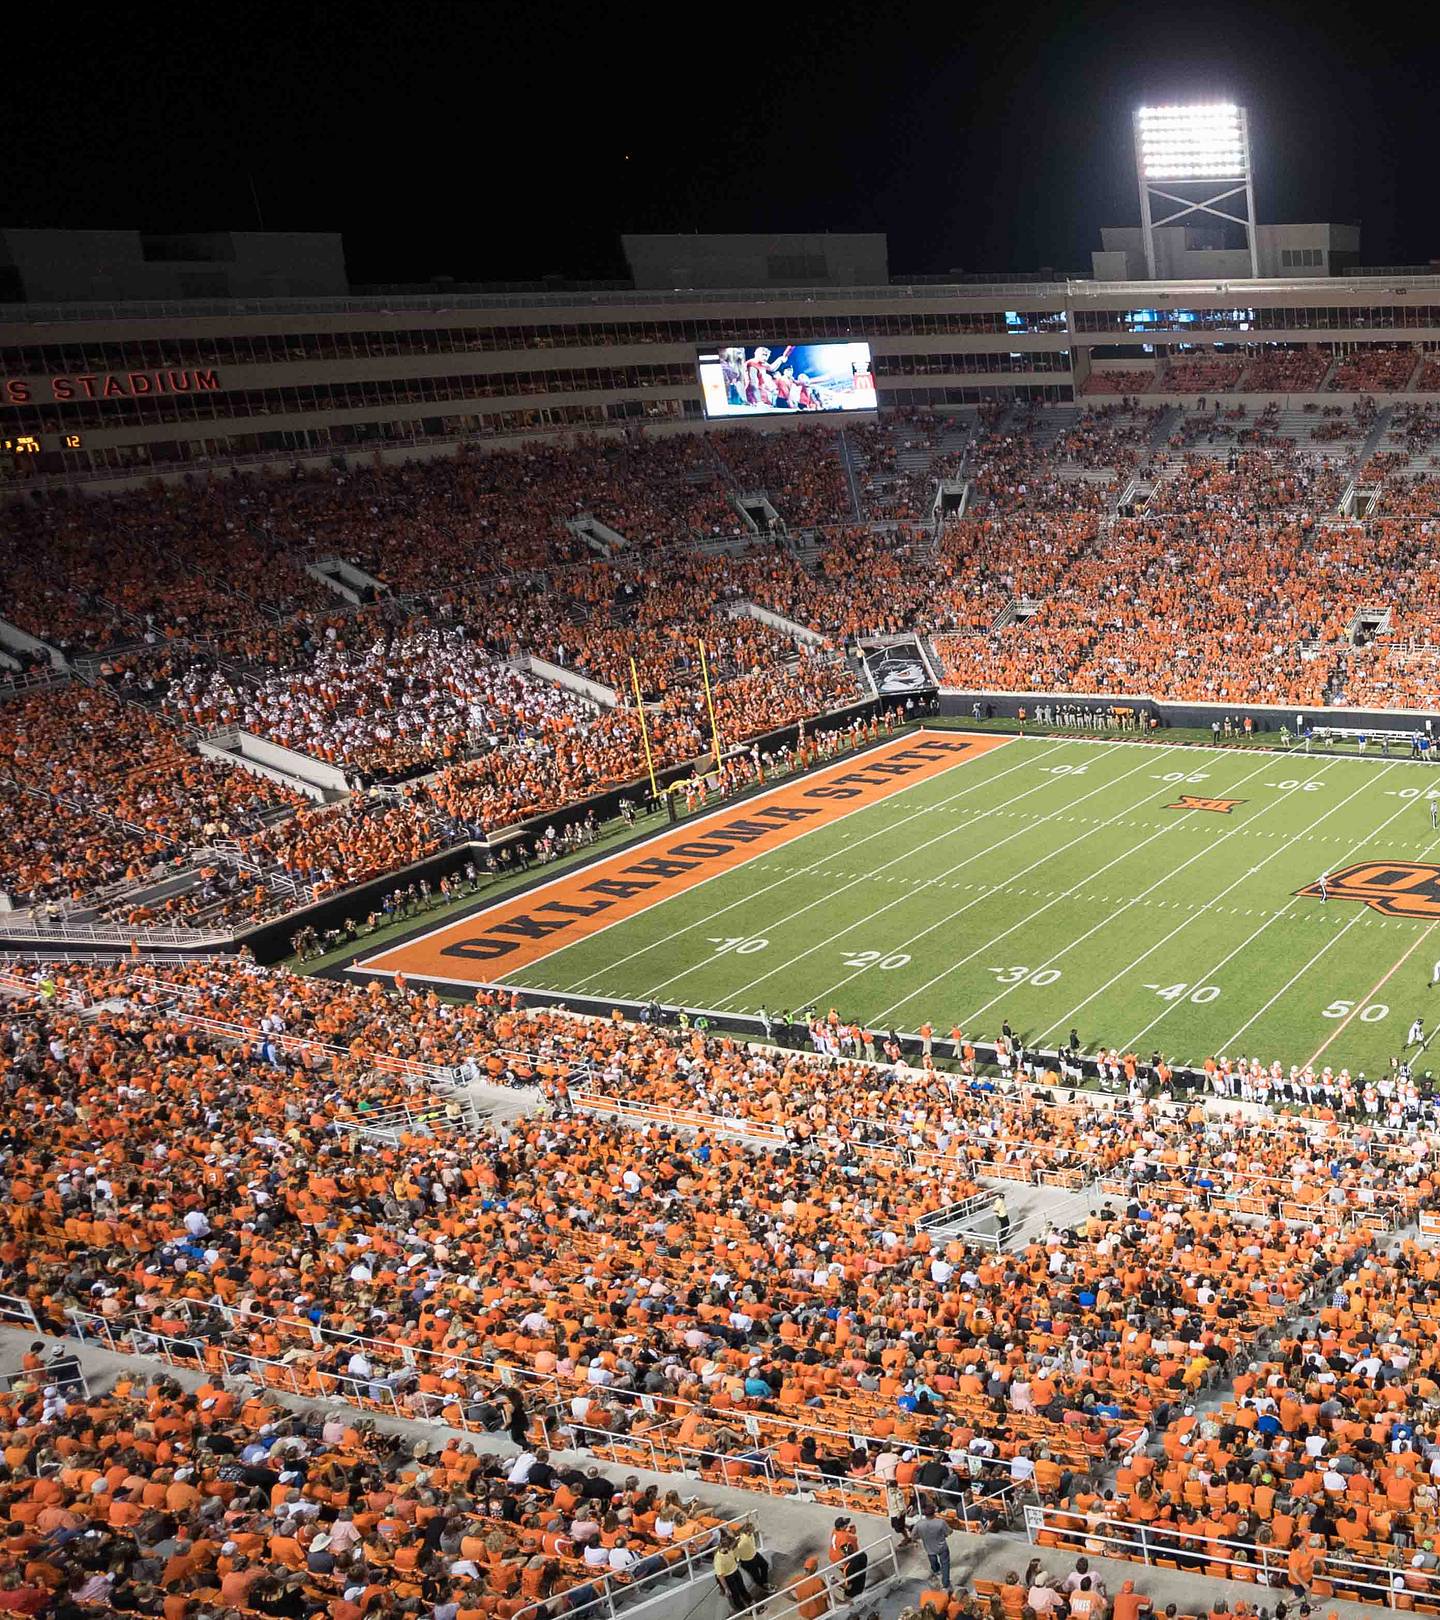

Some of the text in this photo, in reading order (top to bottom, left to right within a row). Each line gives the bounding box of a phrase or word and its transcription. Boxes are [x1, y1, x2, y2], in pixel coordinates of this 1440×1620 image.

[53, 369, 220, 400] STADIUM
[66, 436, 80, 447] 12
[1277, 780, 1326, 791] 30
[439, 740, 973, 960] OKLAHOMA STATE
[715, 937, 769, 954] 10
[843, 951, 912, 969] 20
[996, 966, 1062, 986] 30
[1156, 983, 1221, 1004] 40
[1321, 1000, 1390, 1023] 50
